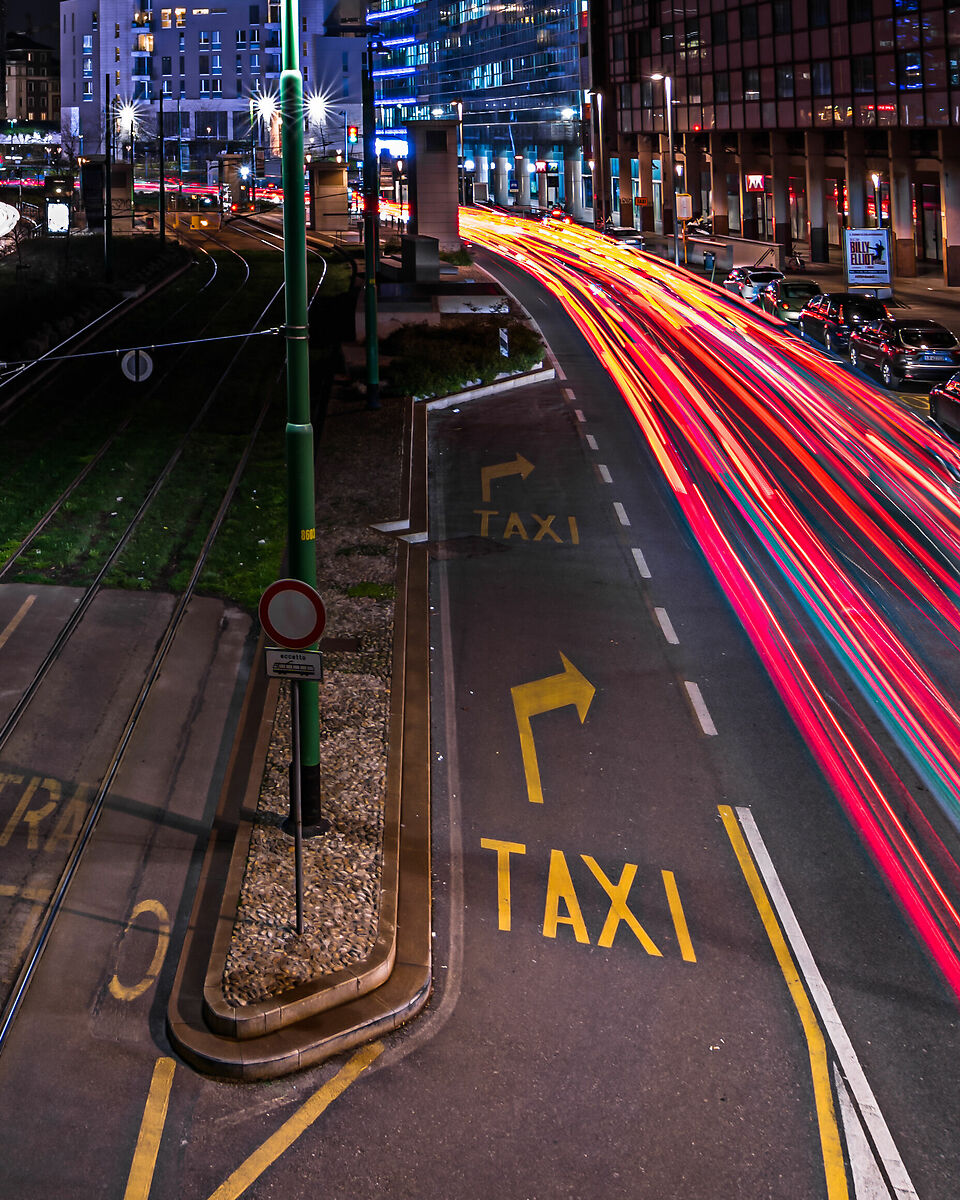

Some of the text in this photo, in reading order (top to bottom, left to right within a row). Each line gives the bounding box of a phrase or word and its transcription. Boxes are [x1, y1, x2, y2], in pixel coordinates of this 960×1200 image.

[850, 241, 870, 253] BILLY
[851, 253, 874, 265] ELLIOT
[473, 509, 580, 545] TAXI
[280, 653, 306, 661] eccetto
[480, 837, 697, 963] TAXI
